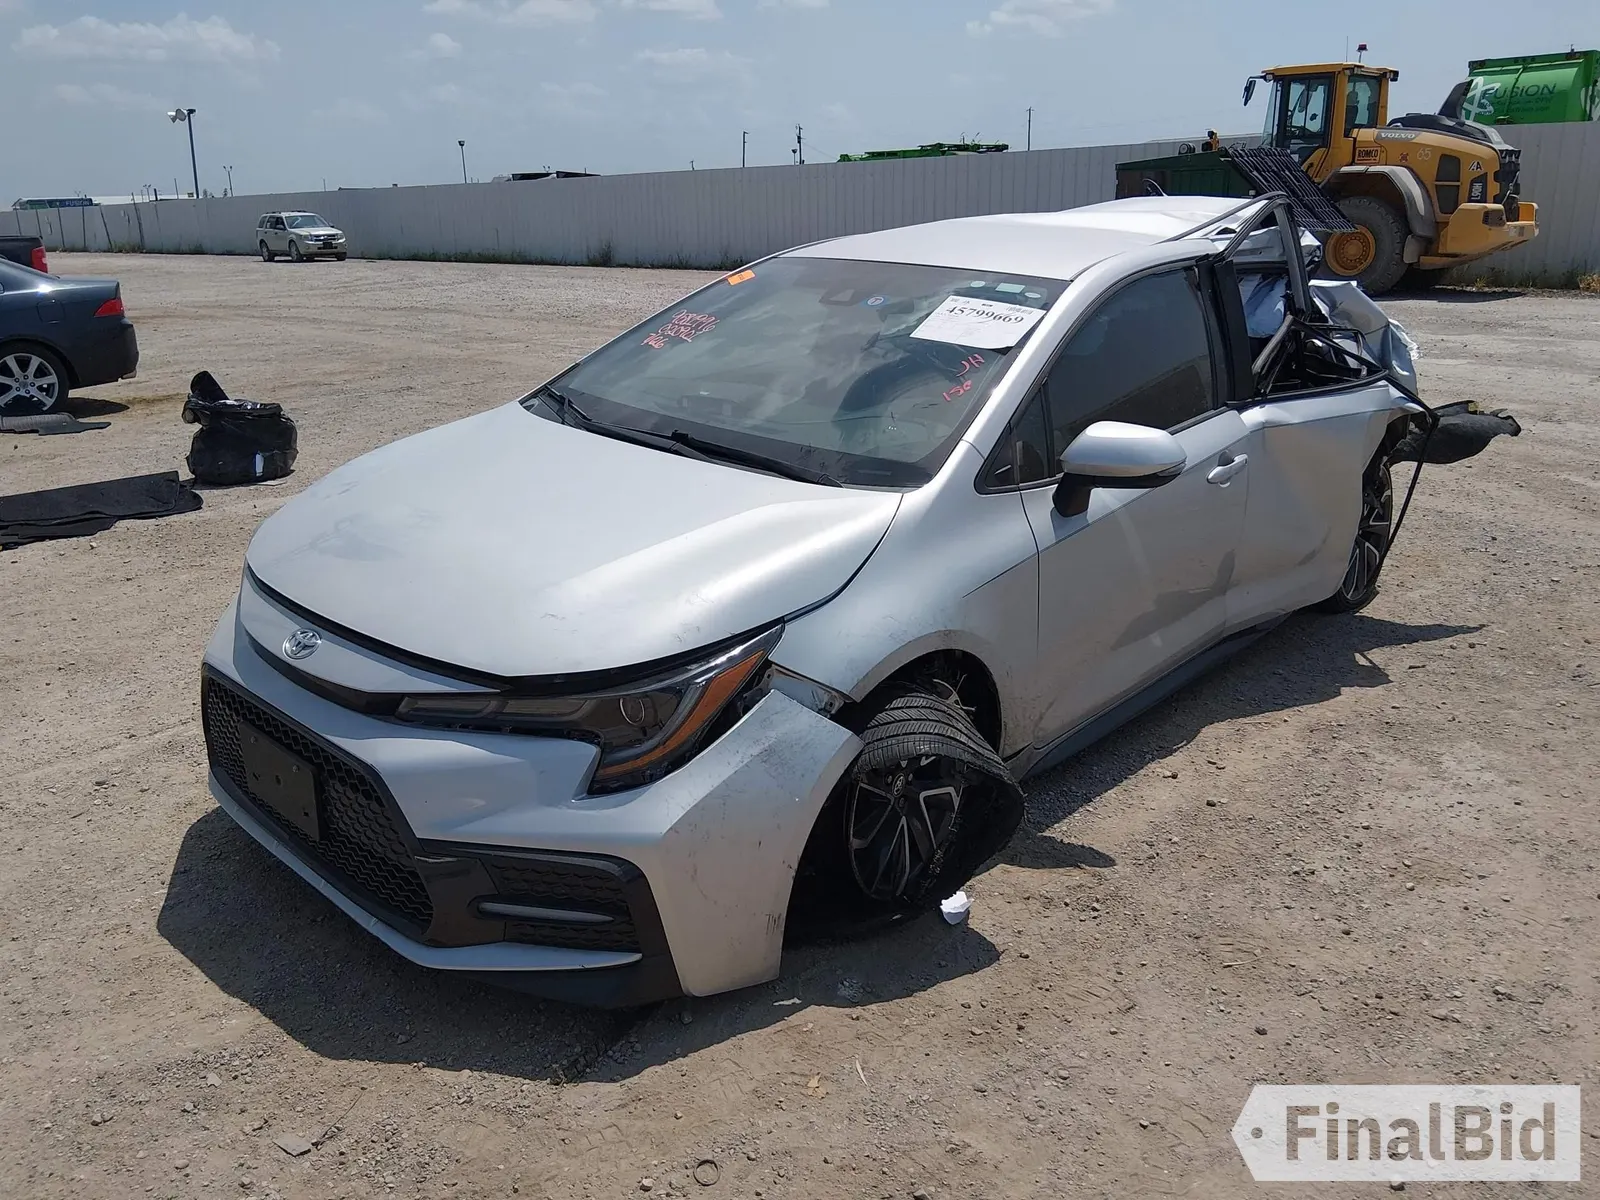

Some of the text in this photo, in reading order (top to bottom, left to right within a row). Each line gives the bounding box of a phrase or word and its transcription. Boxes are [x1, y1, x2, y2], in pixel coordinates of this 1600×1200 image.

[1357, 149, 1379, 158] ROMCO
[1471, 183, 1483, 199] L90H
[946, 305, 1025, 324] 45799669
